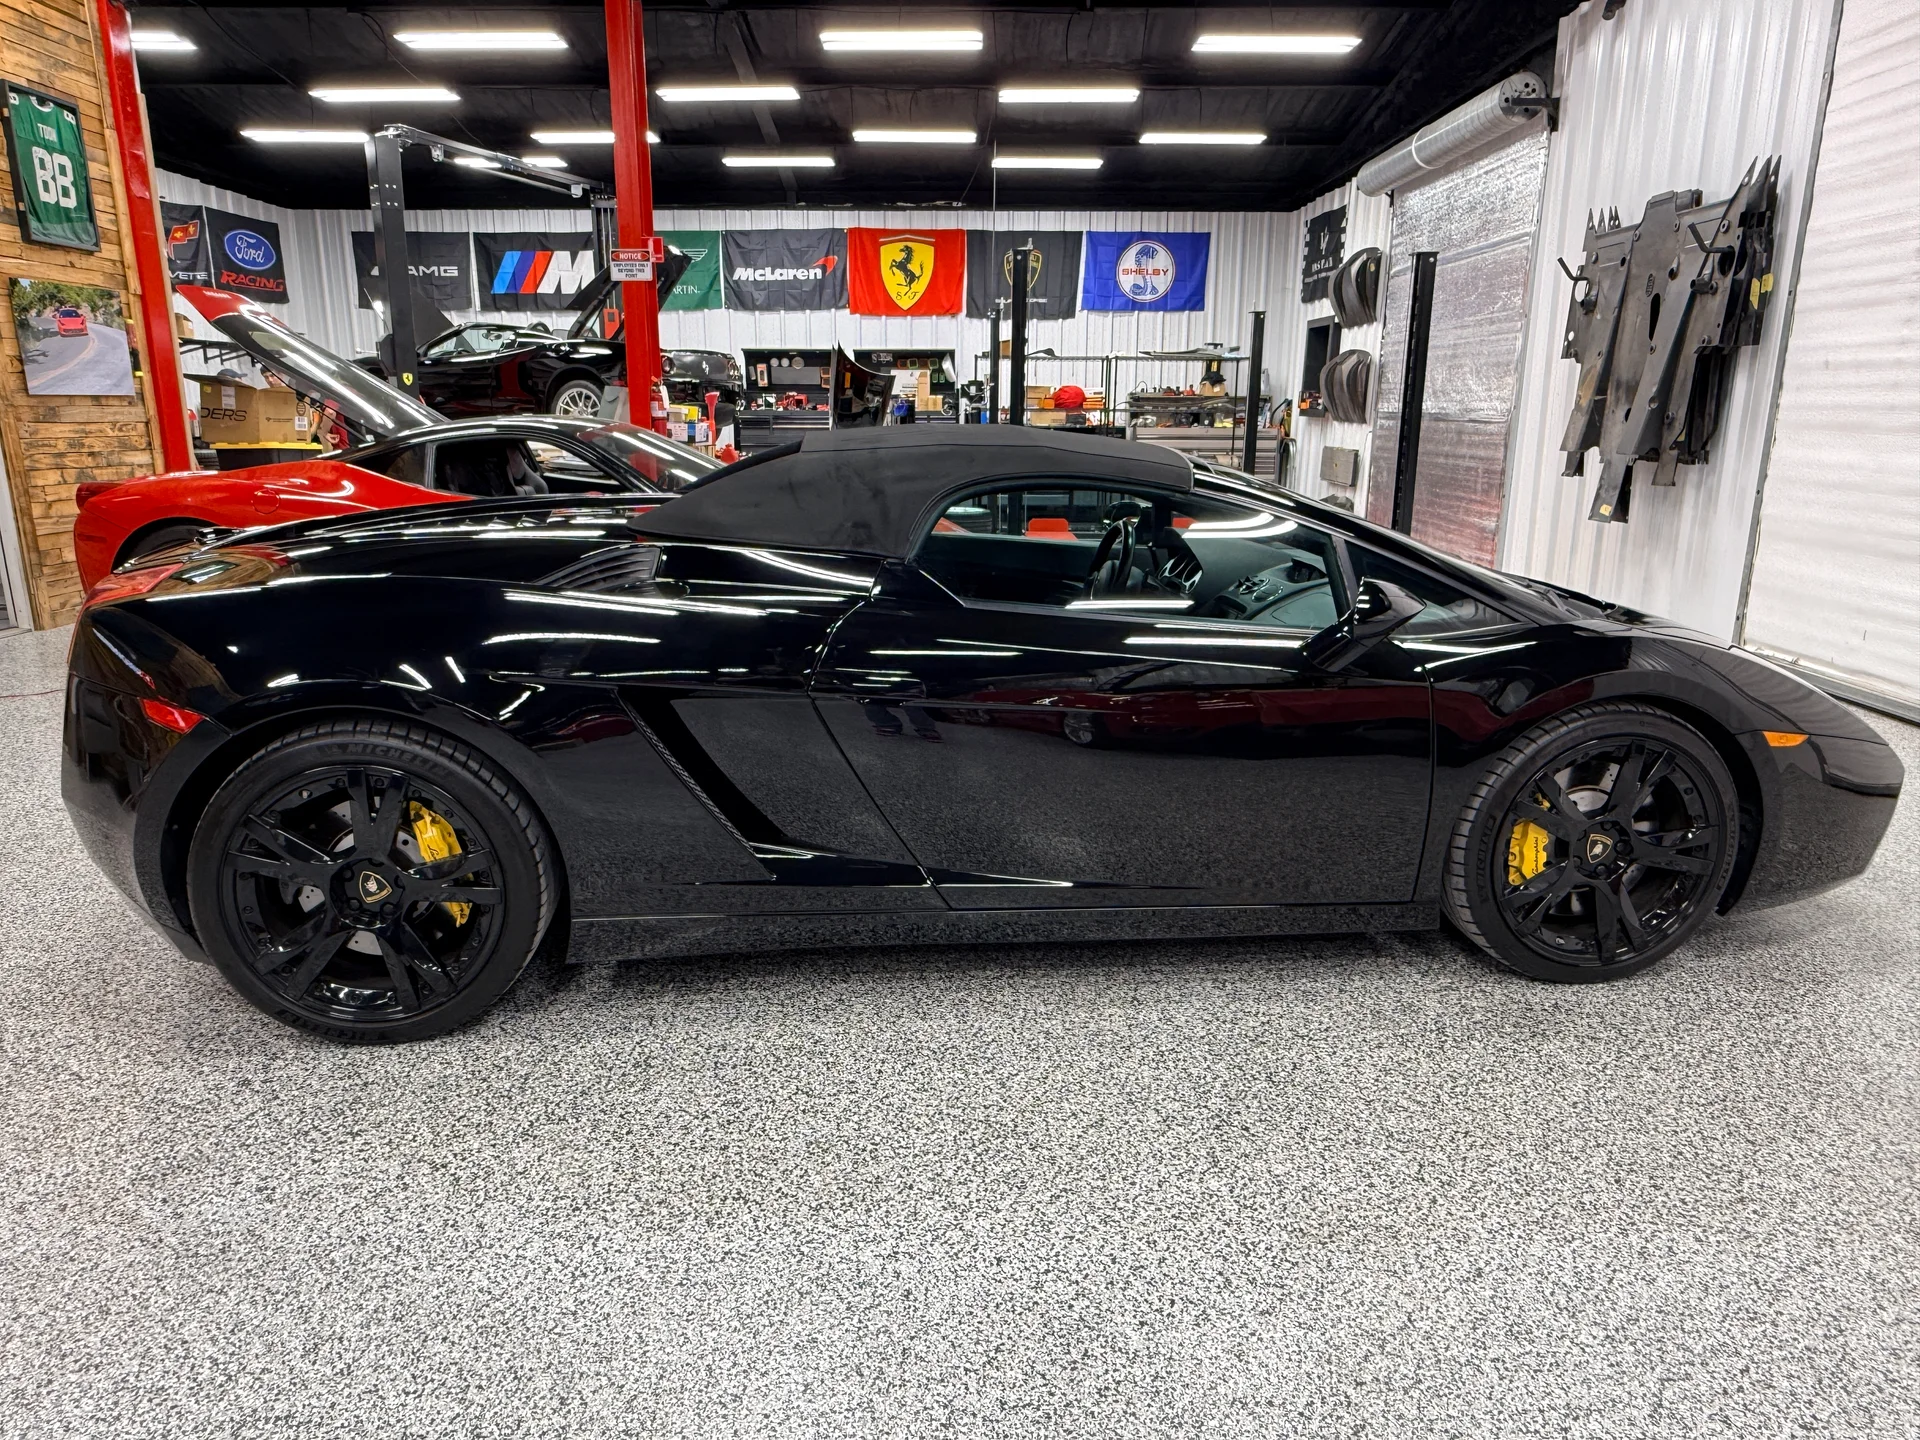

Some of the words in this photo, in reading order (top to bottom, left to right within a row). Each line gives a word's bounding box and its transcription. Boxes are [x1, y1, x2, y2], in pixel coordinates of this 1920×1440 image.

[32, 146, 77, 209] 88
[235, 235, 264, 262] Ford
[619, 252, 642, 260] NOTICE
[168, 271, 209, 280] VETTE
[732, 267, 822, 281] McLaren
[1122, 268, 1169, 276] SHELBY
[220, 269, 284, 292] RACING
